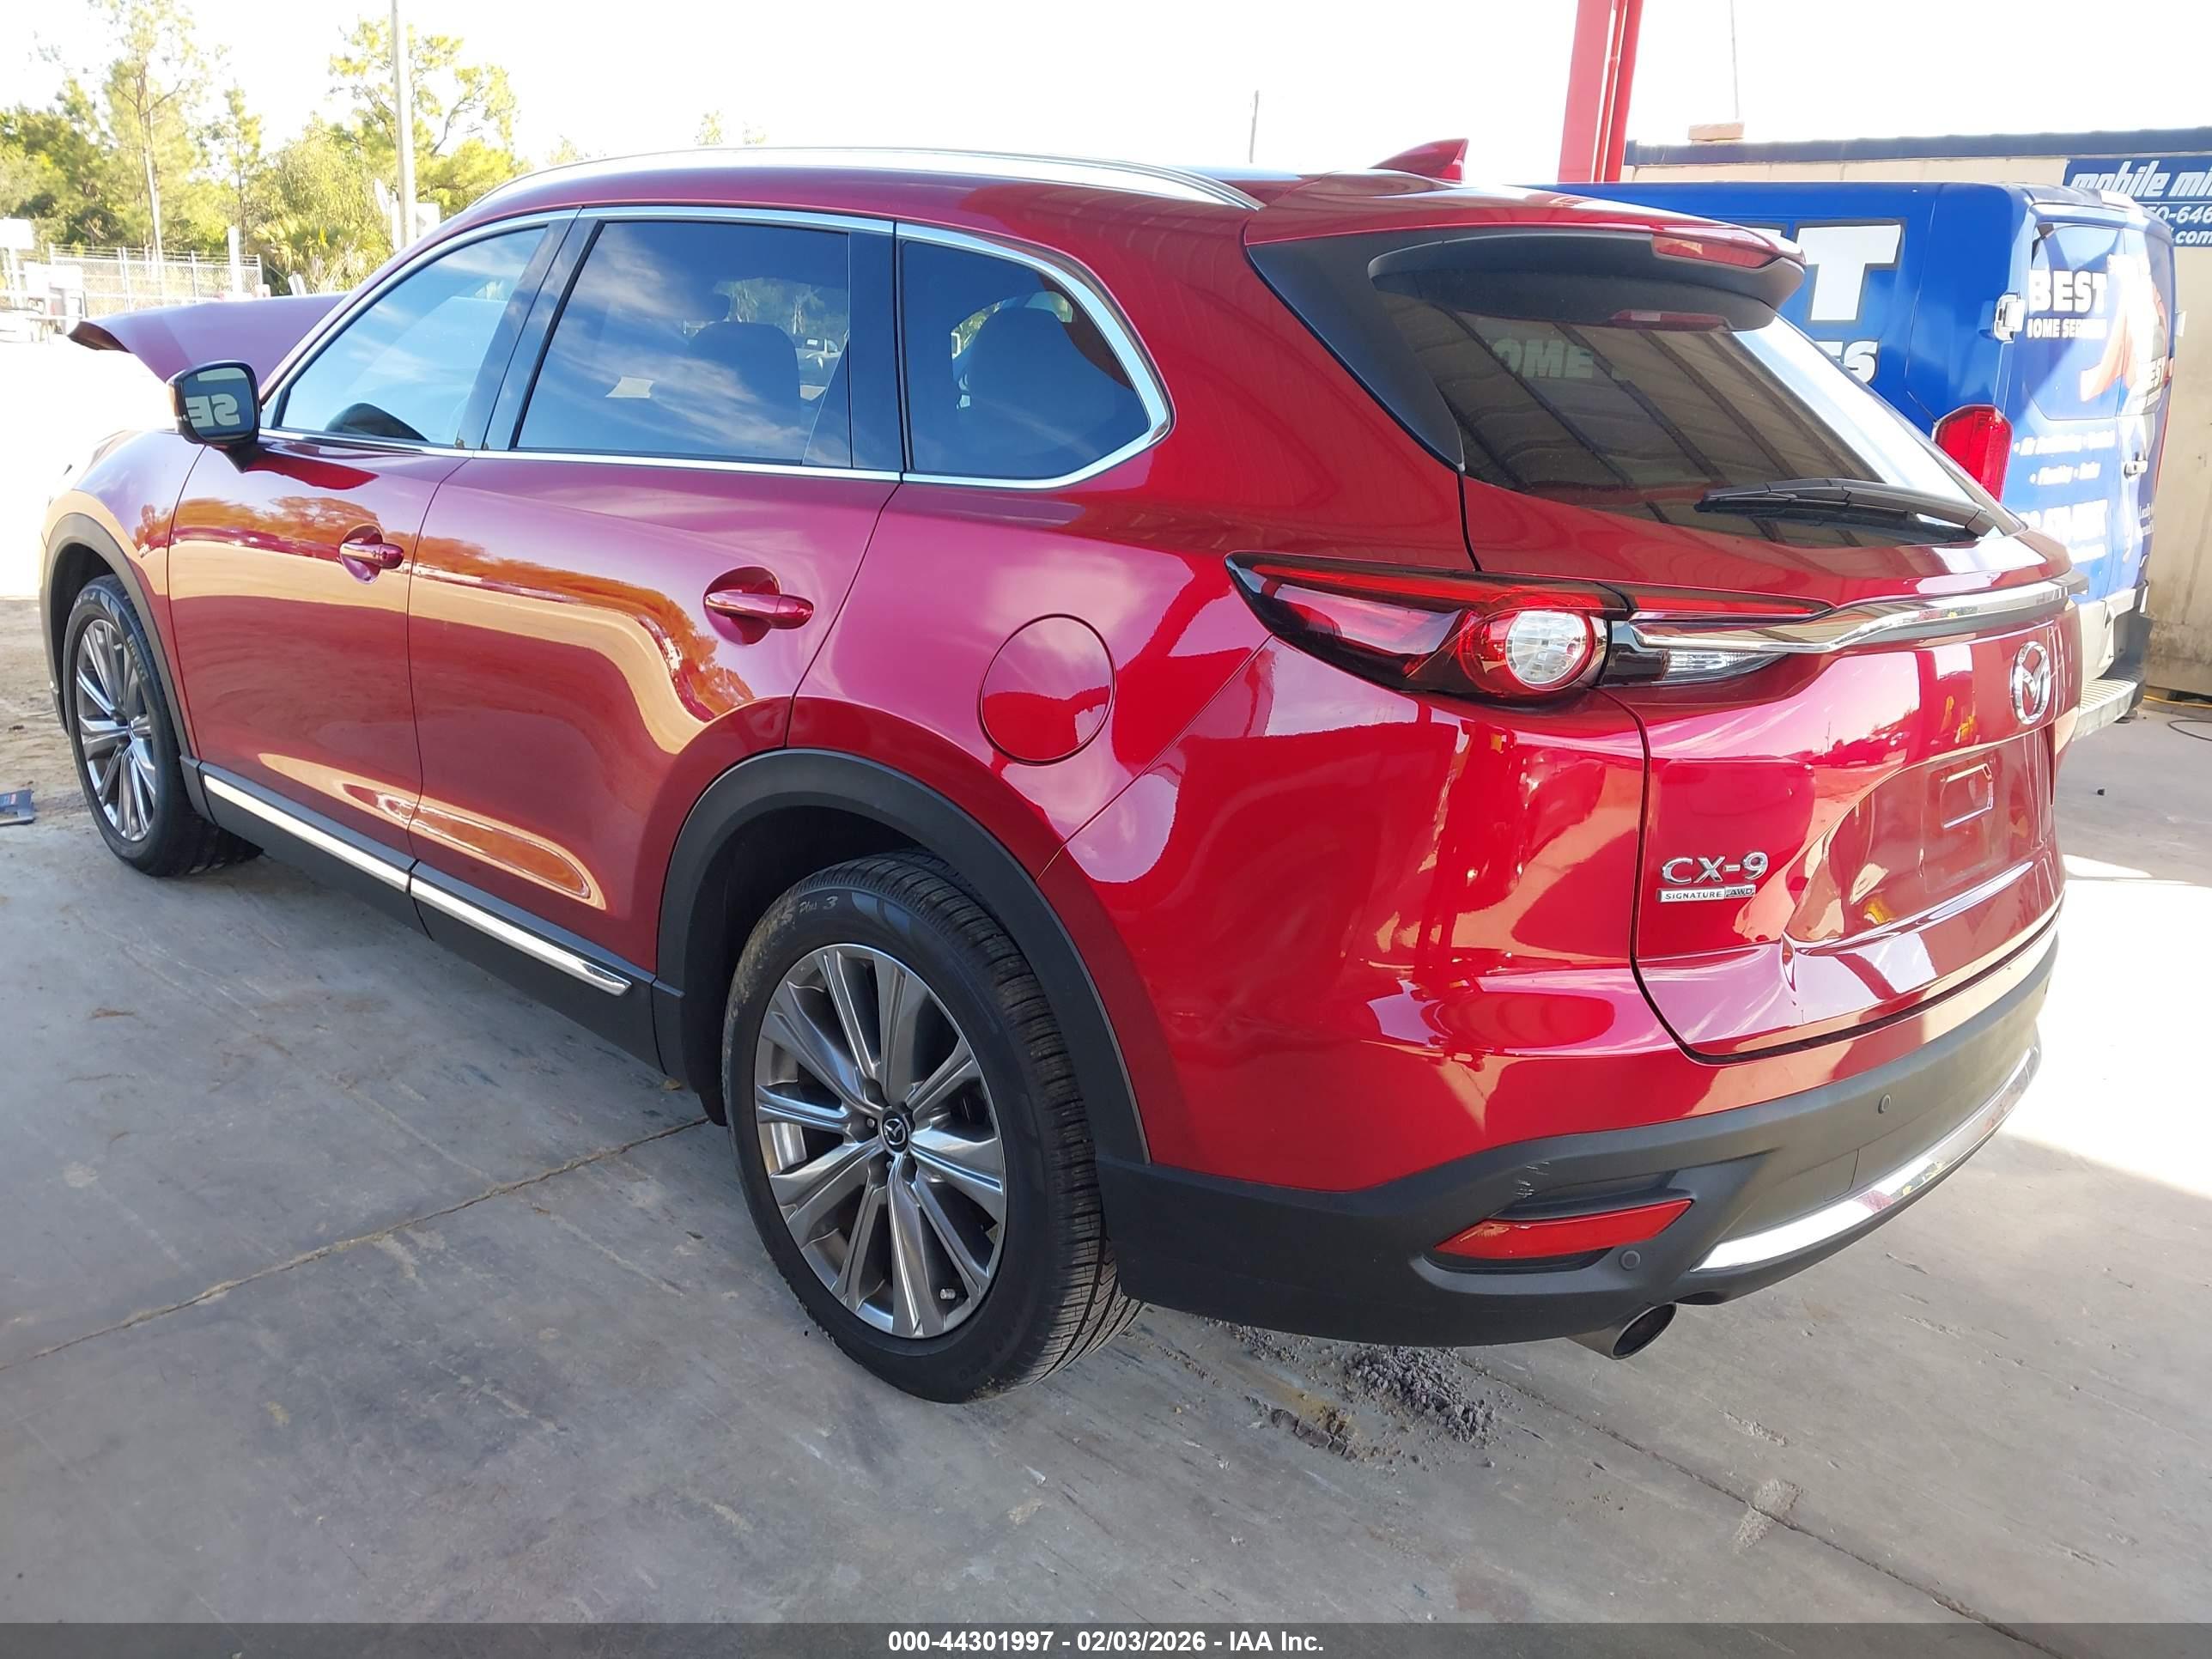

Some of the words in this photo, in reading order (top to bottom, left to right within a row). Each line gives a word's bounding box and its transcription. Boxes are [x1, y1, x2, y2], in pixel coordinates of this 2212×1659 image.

[2070, 161, 2171, 197] mobile
[2029, 270, 2108, 313] BEST
[1662, 851, 1769, 884] CX-9
[1665, 891, 1722, 900] SIGNATURE
[1728, 888, 1753, 896] AWD
